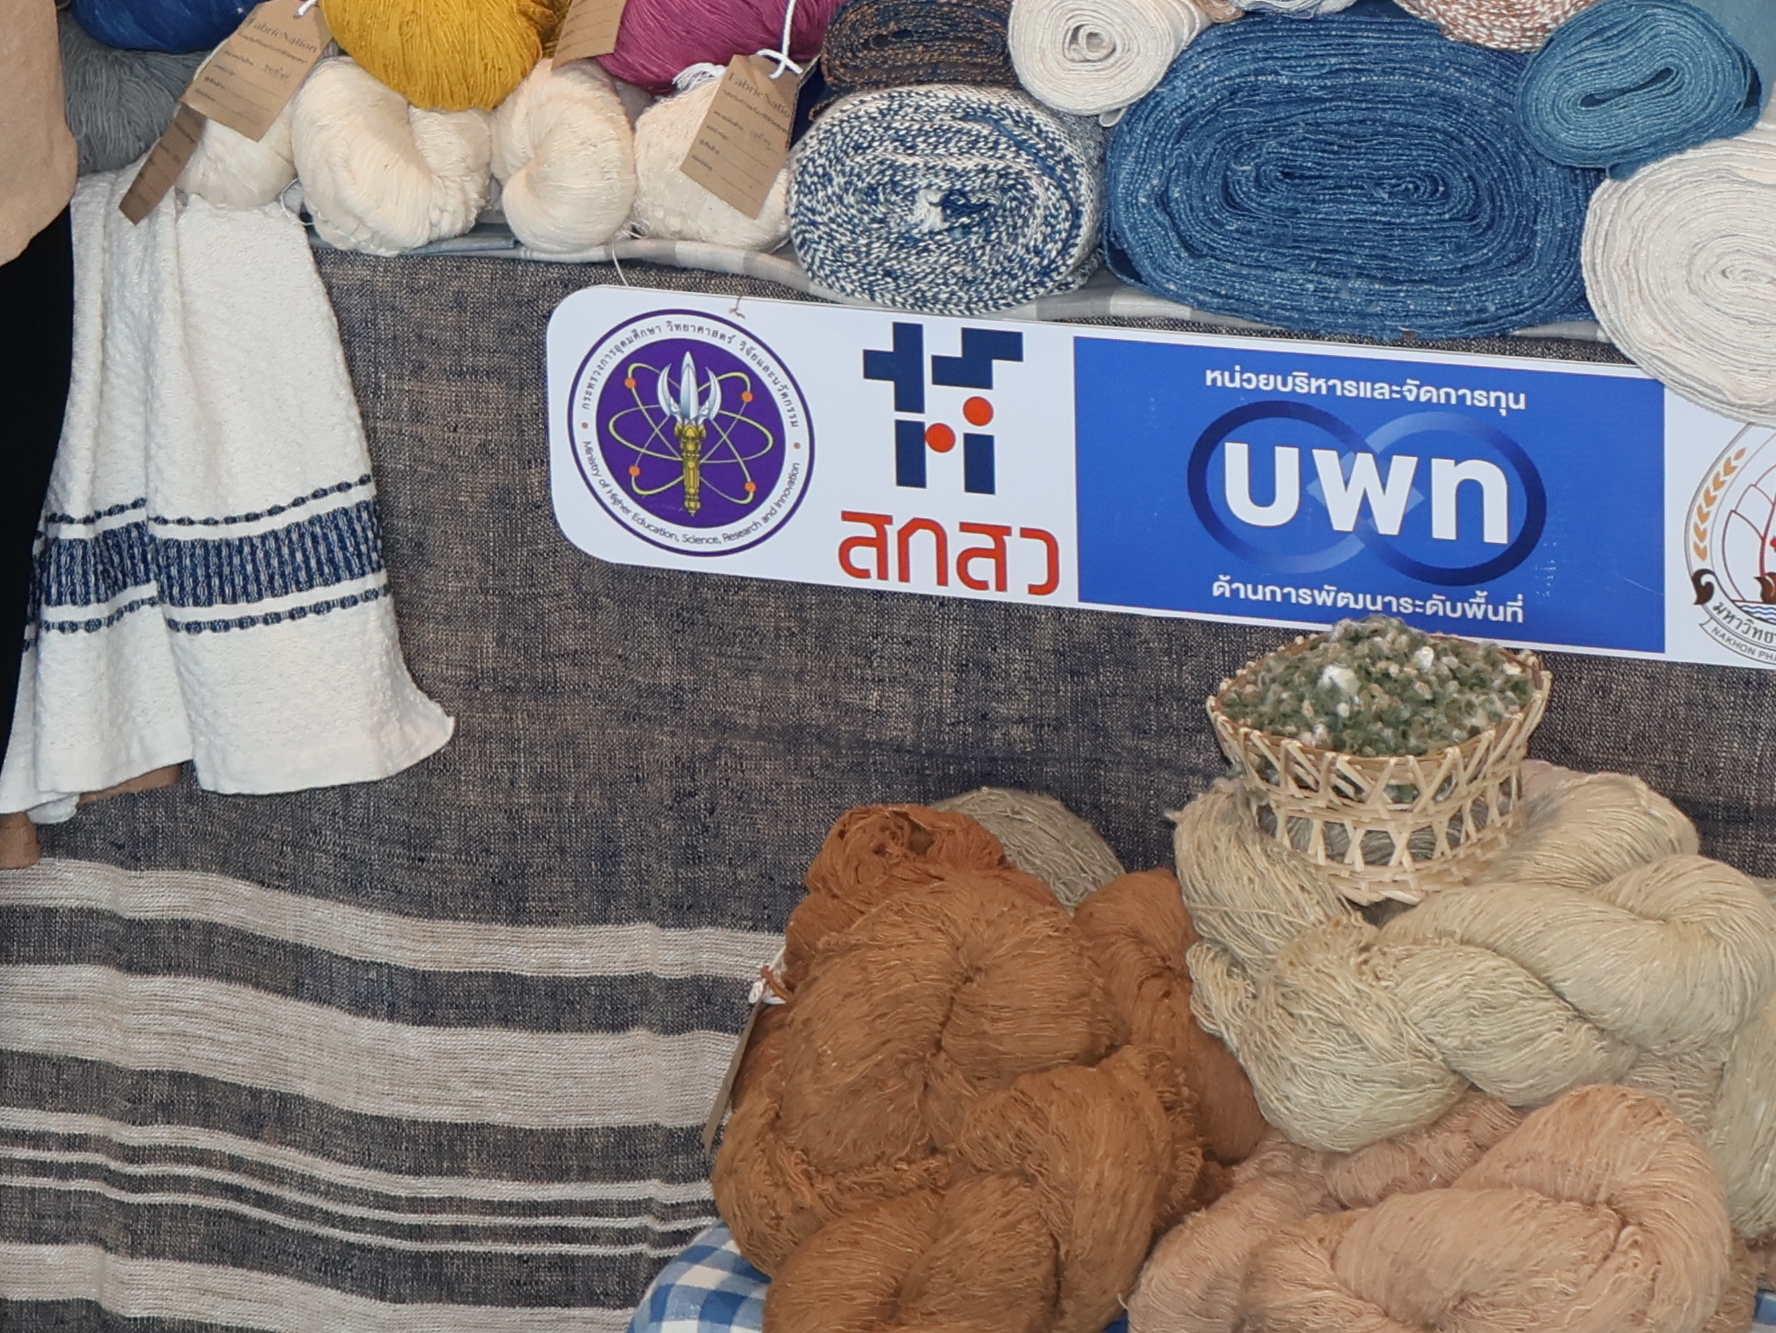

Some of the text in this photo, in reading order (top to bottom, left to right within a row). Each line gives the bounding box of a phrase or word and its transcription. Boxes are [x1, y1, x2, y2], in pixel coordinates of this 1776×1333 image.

[1205, 364, 1528, 415] หน่วยบริหารและจัดการทุน
[583, 440, 801, 546] Ministry of Higher Education, Science, Research and Innovation
[1223, 439, 1511, 546] บพท
[837, 509, 1060, 597] สกสว
[1211, 573, 1526, 625] ด้านการพัฒนาระดับพื้นที่
[1711, 626, 1757, 656] NAKHON
